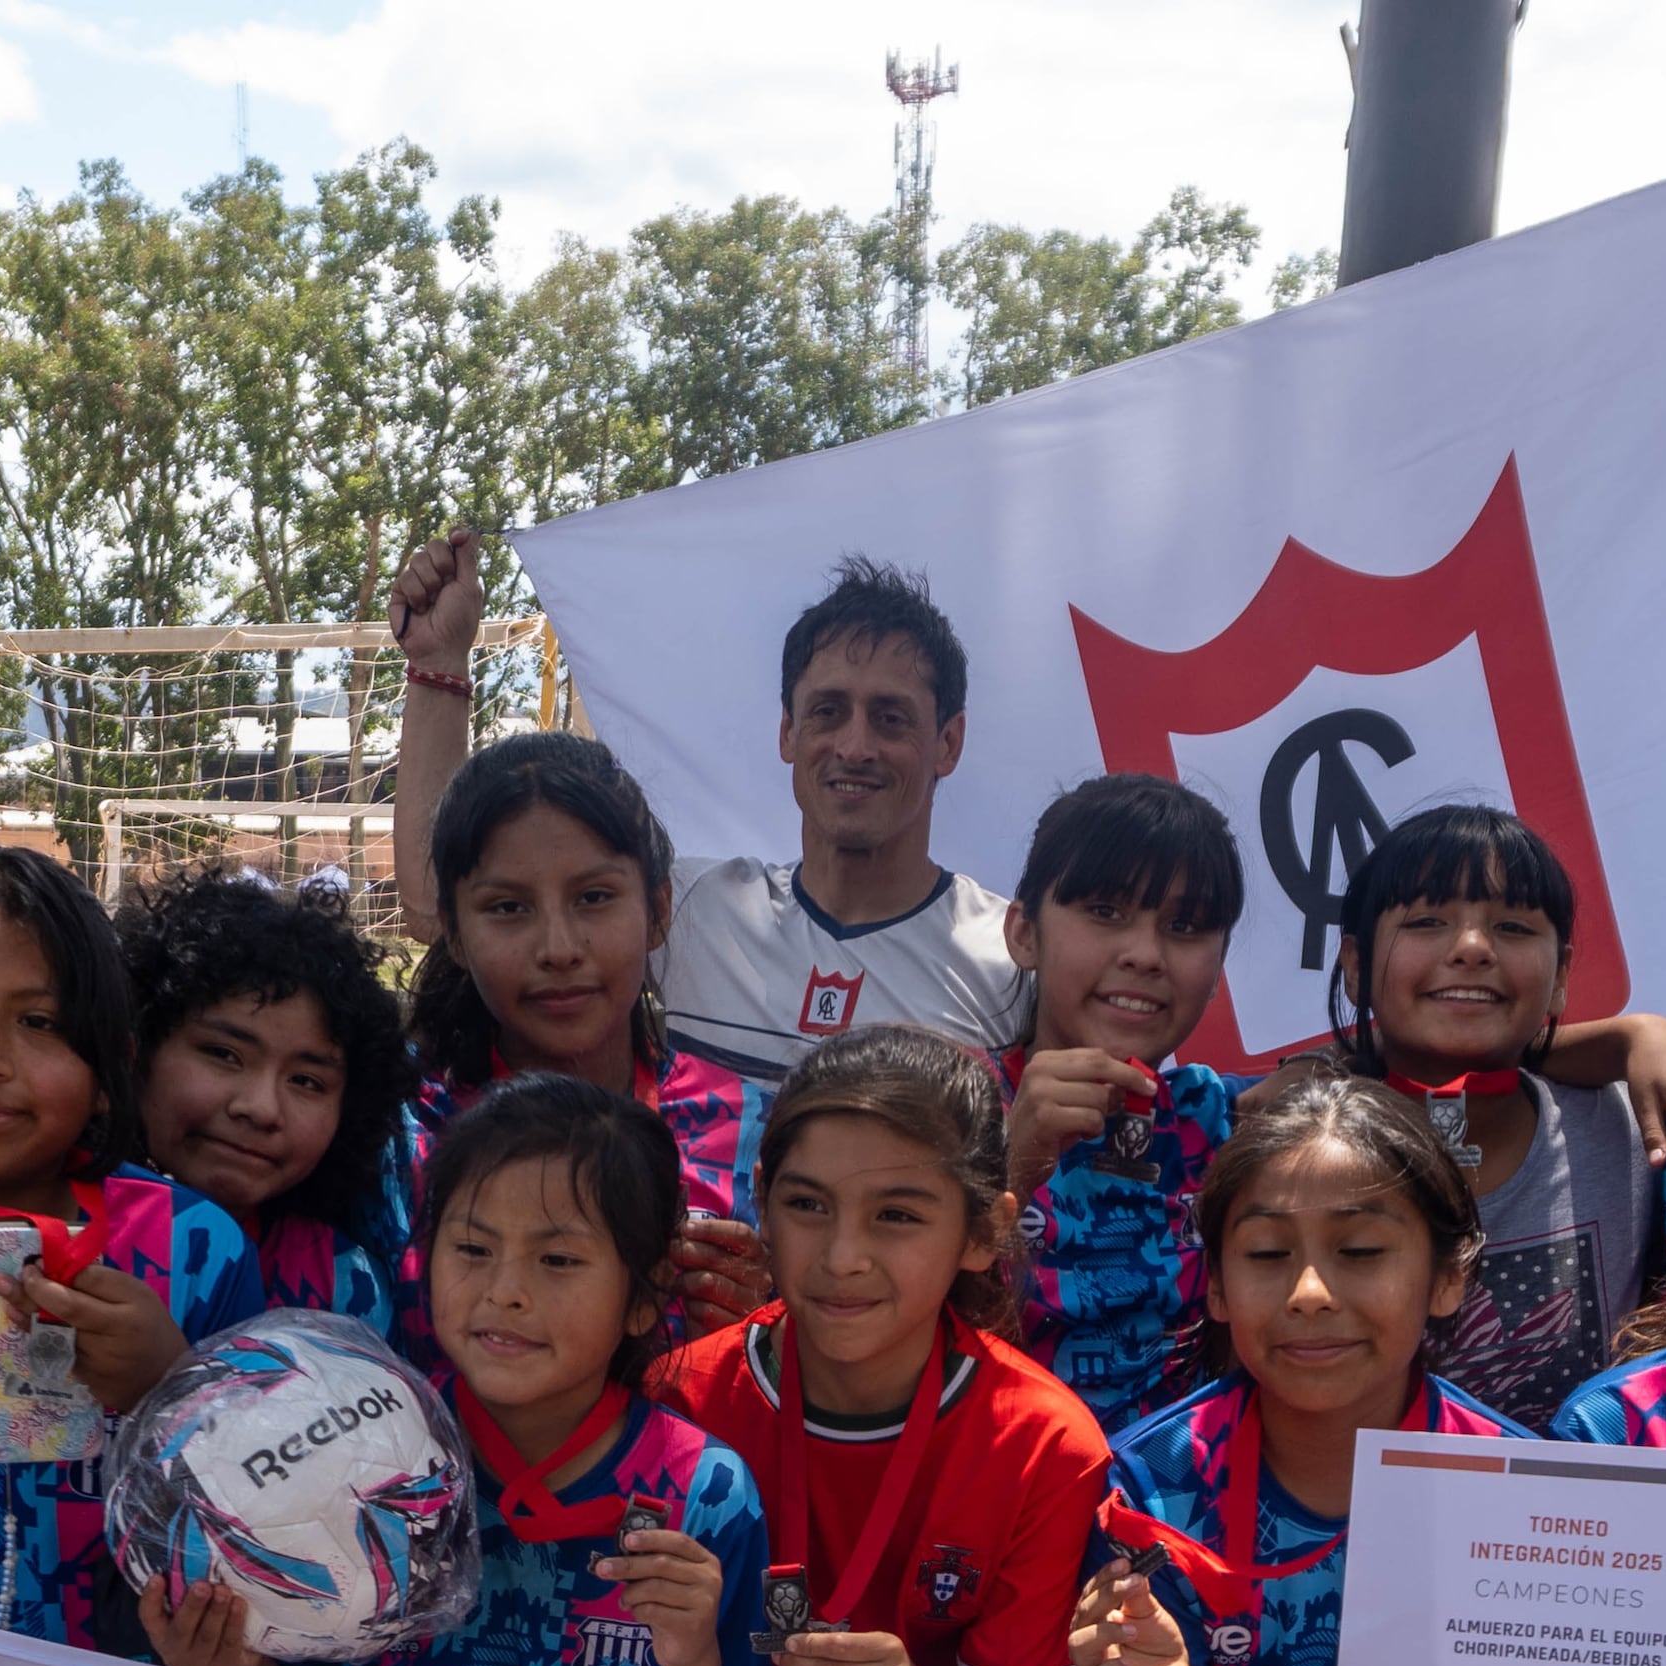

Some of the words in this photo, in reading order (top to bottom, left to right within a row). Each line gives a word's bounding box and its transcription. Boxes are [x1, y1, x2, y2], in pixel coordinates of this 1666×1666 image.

[240, 1384, 404, 1491] Reebok
[1529, 1515, 1609, 1538] TORNEO
[1469, 1541, 1605, 1568] INTEGRACIÓN
[1611, 1551, 1663, 1572] 2025
[1474, 1578, 1645, 1609] CAMPEONES
[1445, 1618, 1536, 1639] ALMUERZO
[1540, 1625, 1585, 1643] PARA
[1589, 1628, 1609, 1644] EL
